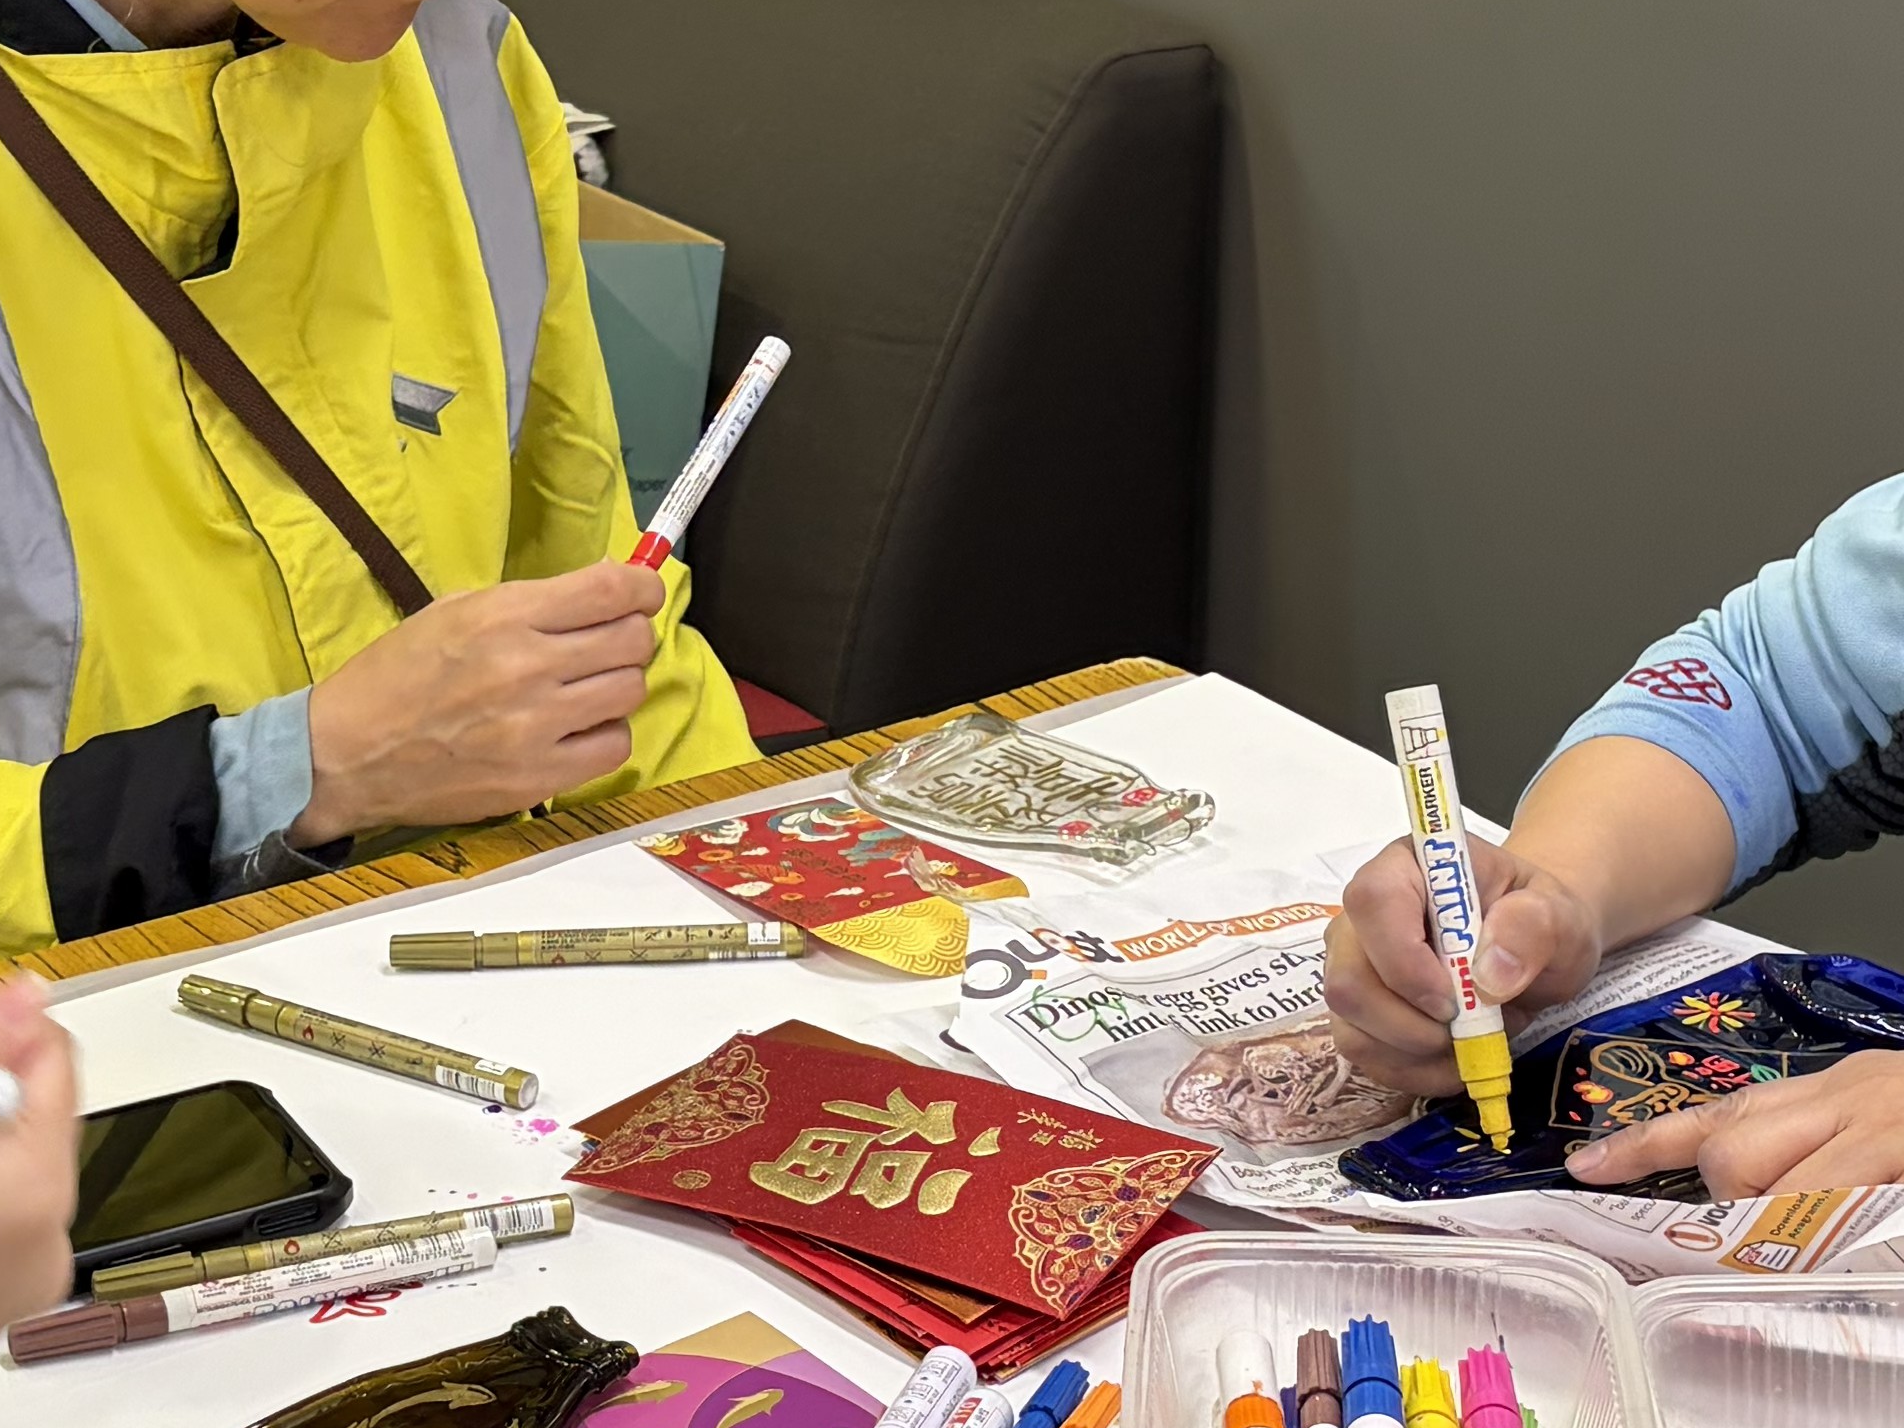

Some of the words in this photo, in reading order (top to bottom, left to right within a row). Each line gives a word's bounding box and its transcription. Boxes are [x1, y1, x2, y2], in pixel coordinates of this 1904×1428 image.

[1422, 765, 1448, 833] MARKER
[1422, 837, 1475, 956] PAINT
[1204, 968, 1270, 1005] gives
[1450, 956, 1476, 1011] uni
[1183, 1006, 1243, 1037] link
[1244, 1000, 1276, 1022] to
[1770, 1192, 1808, 1237] Download
